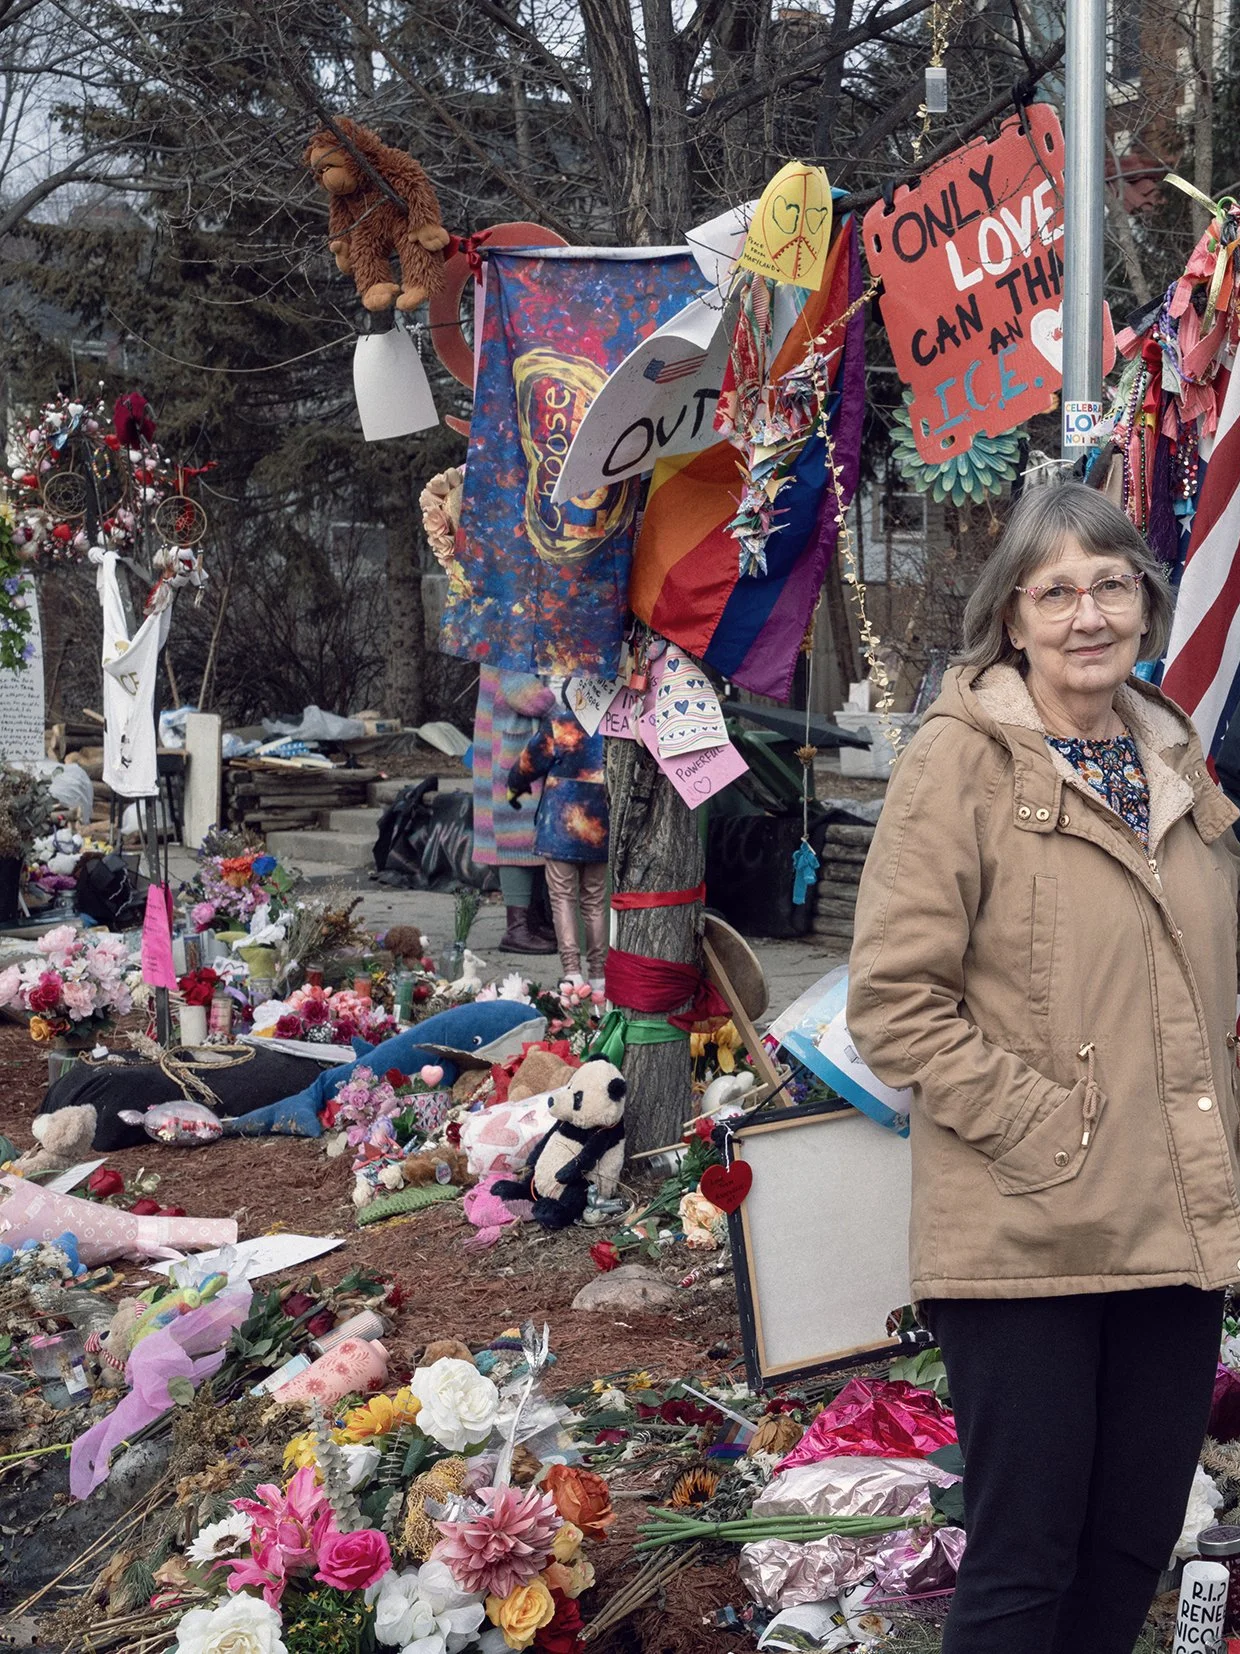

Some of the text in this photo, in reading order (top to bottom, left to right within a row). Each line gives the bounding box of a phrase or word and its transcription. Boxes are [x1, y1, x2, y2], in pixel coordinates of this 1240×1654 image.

[892, 153, 995, 263] ONLY
[944, 177, 1064, 292] LOVE
[995, 247, 1064, 316] THA
[911, 293, 984, 367] CAN
[988, 315, 1024, 356] AN
[602, 388, 721, 477] OUT
[605, 711, 629, 732] PEA
[1181, 1599, 1227, 1625] RENE
